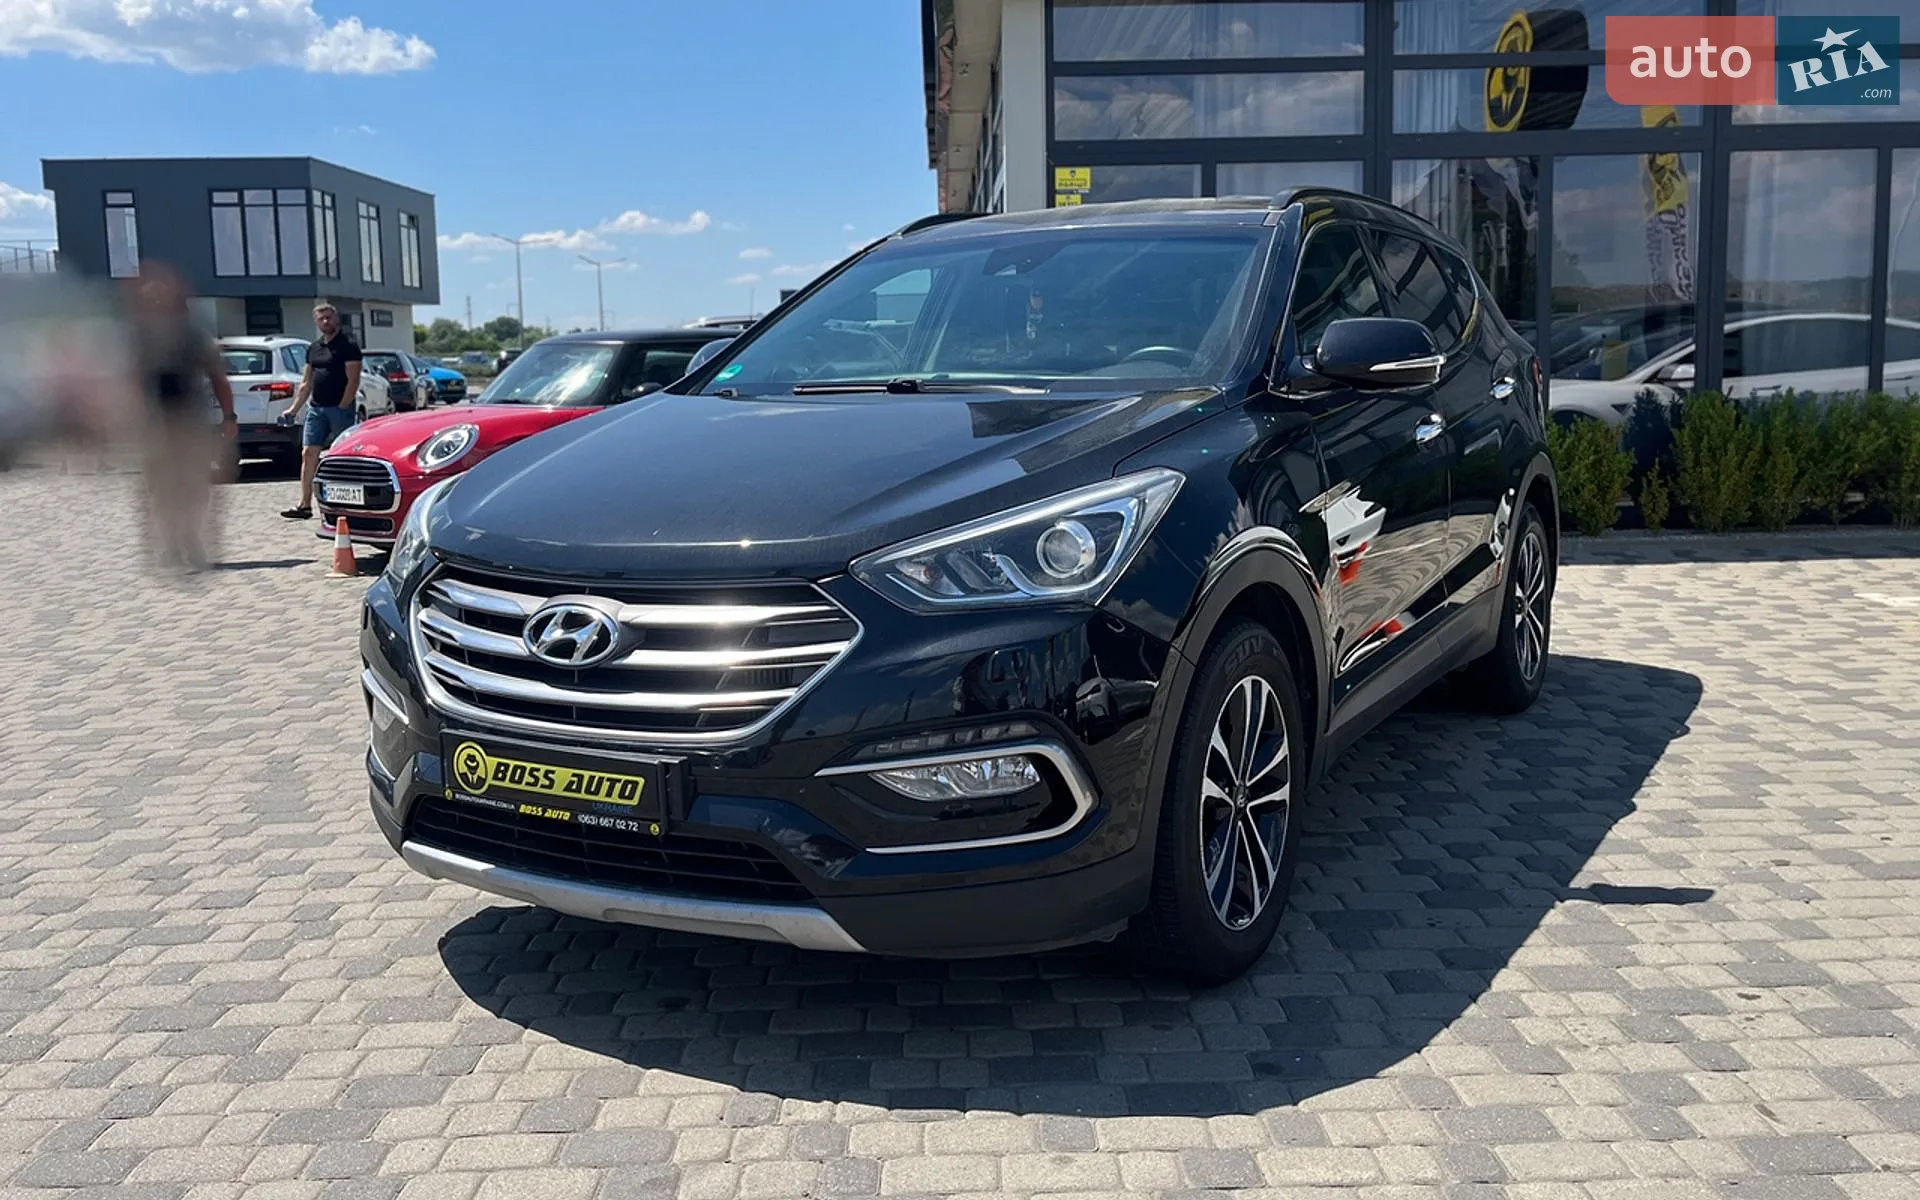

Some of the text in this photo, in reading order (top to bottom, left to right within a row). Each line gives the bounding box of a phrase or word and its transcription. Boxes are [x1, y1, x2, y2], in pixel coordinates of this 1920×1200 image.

[492, 761, 640, 801] BOSS AUTO
[518, 804, 543, 817] BOSS
[544, 809, 572, 821] AUTO
